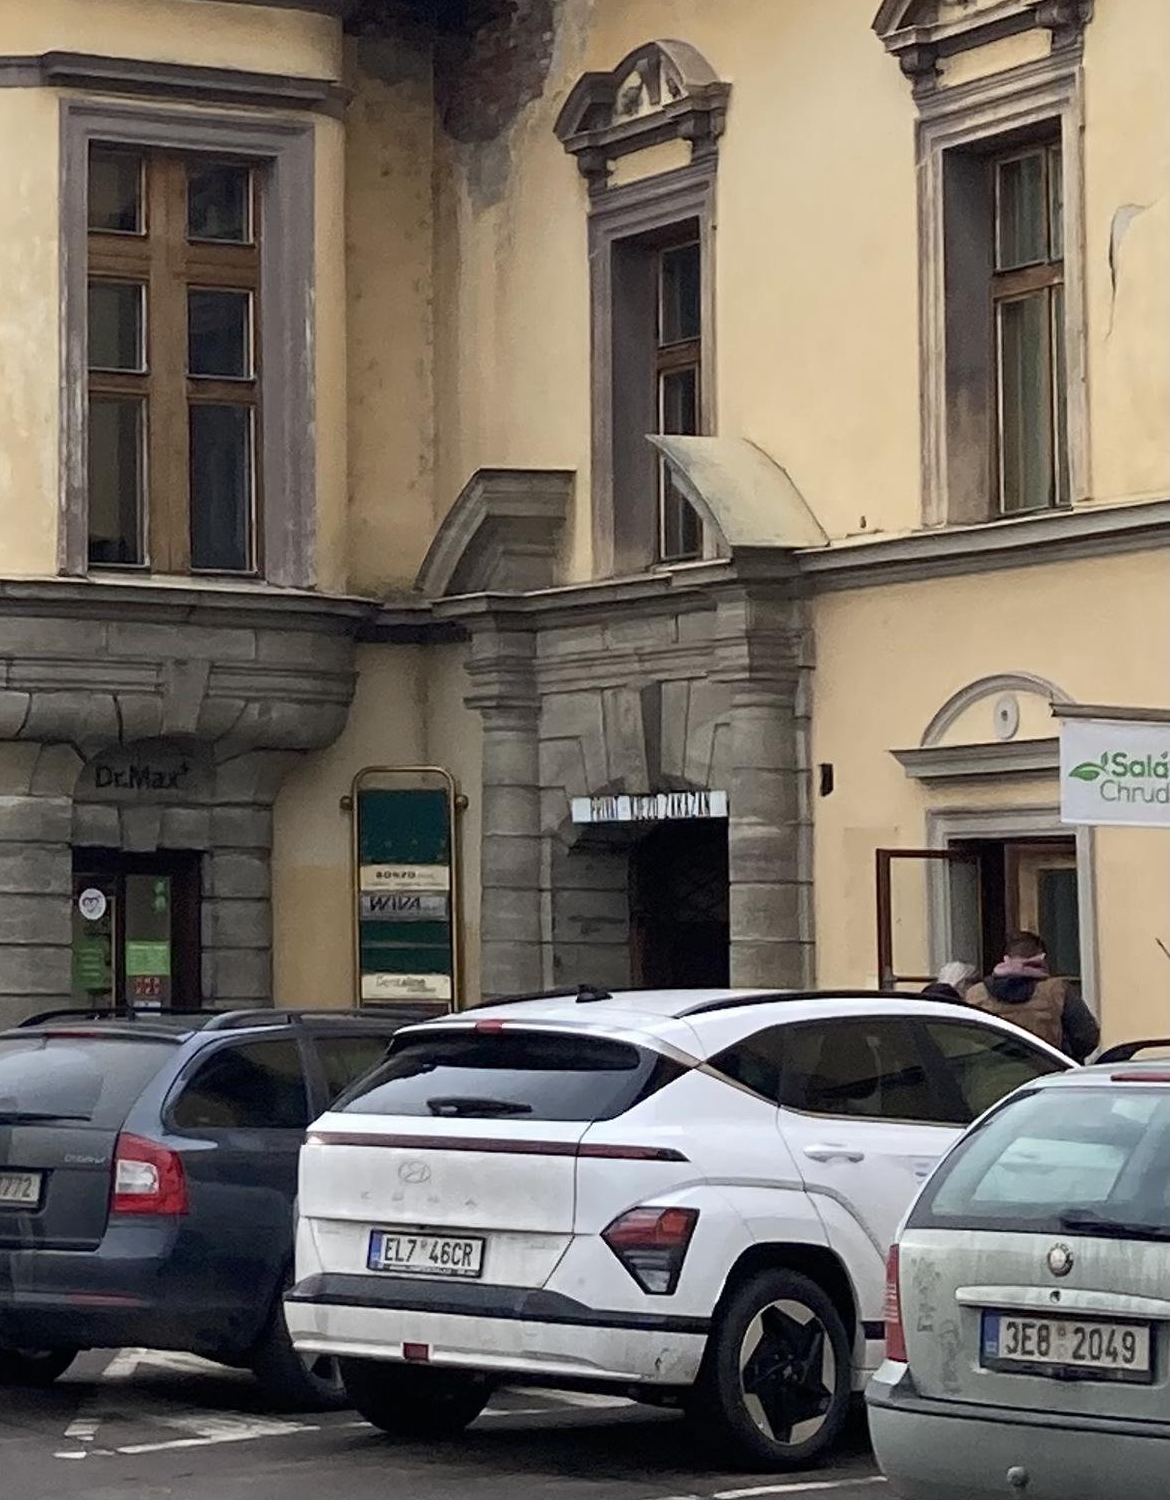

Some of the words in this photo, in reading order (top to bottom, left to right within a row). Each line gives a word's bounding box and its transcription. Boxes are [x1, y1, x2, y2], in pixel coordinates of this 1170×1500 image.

[1100, 779, 1170, 803] Chrud
[384, 1237, 417, 1262] EL7
[428, 1240, 473, 1267] 46CR
[1006, 1321, 1051, 1357] 3E8
[1072, 1326, 1136, 1364] 2049
